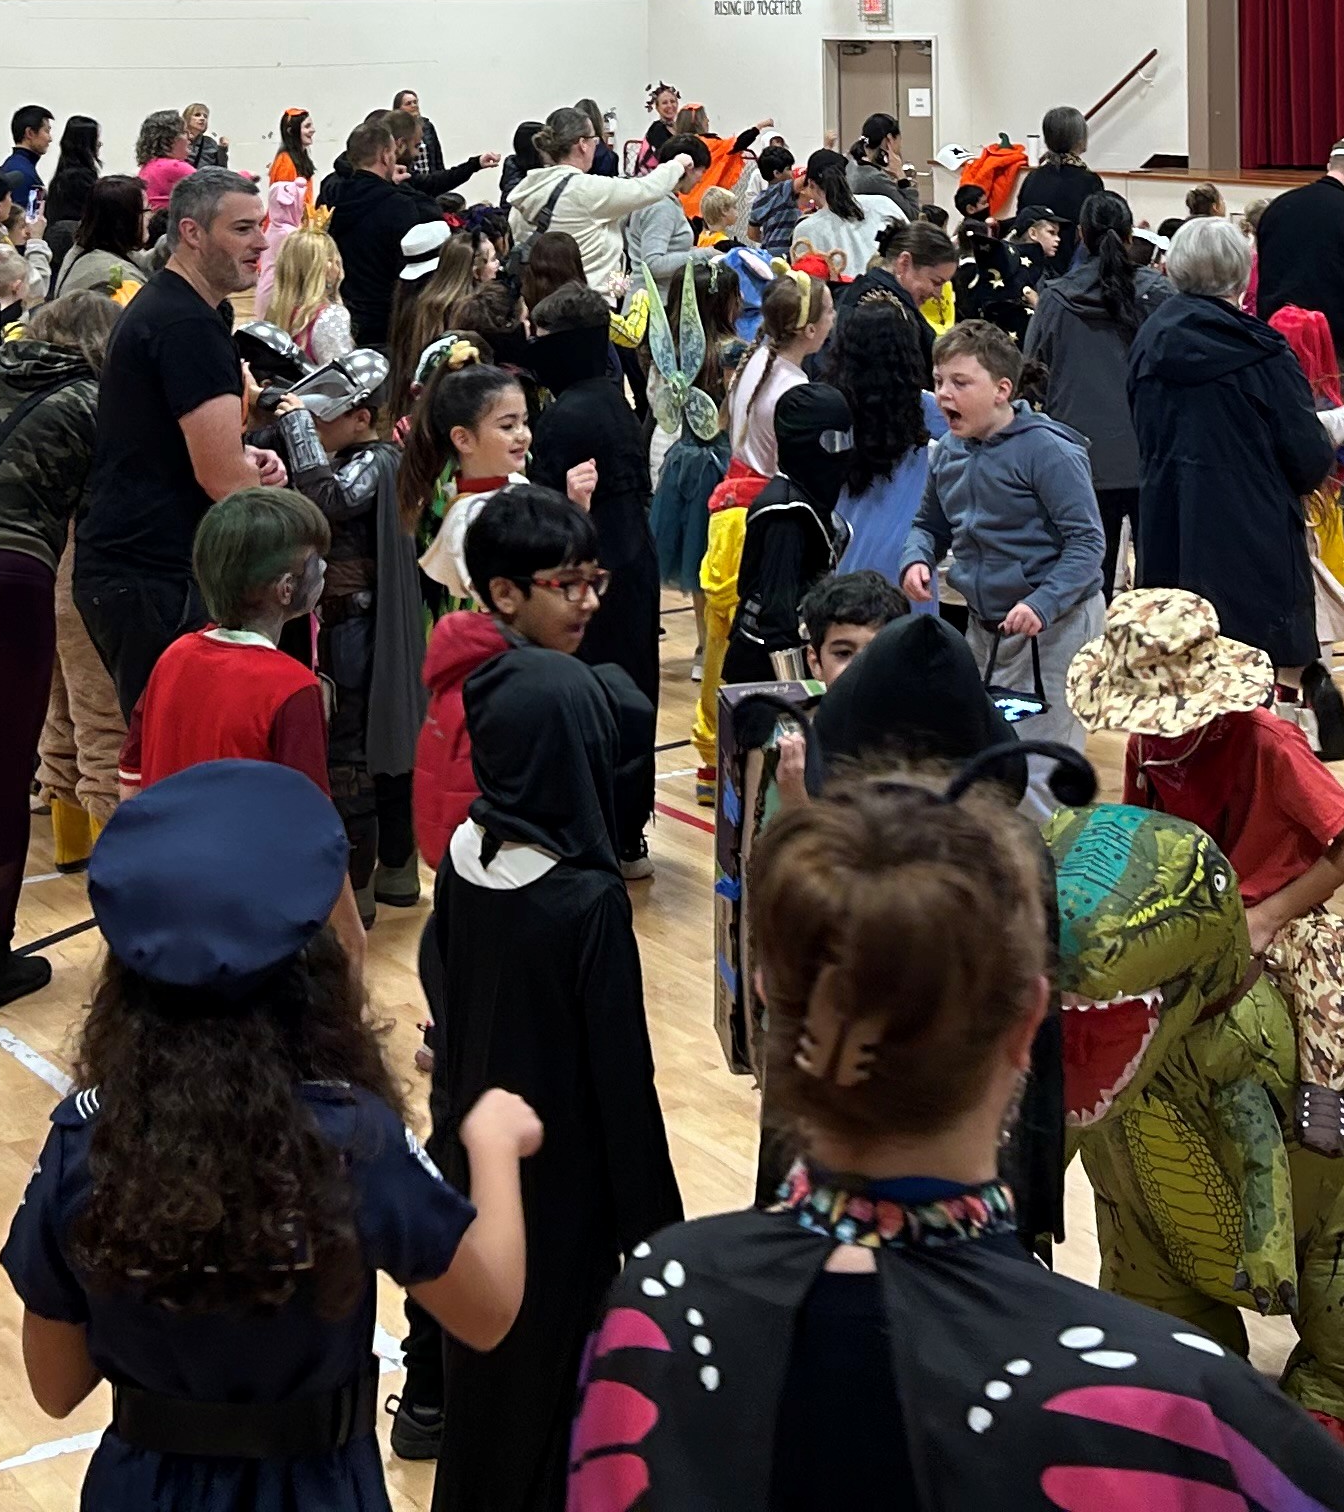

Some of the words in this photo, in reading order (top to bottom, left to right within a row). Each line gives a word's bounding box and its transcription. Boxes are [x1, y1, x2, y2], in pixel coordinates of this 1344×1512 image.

[714, 0, 742, 16] RISING
[743, 0, 755, 15] UP
[757, 0, 802, 15] TOGETHER
